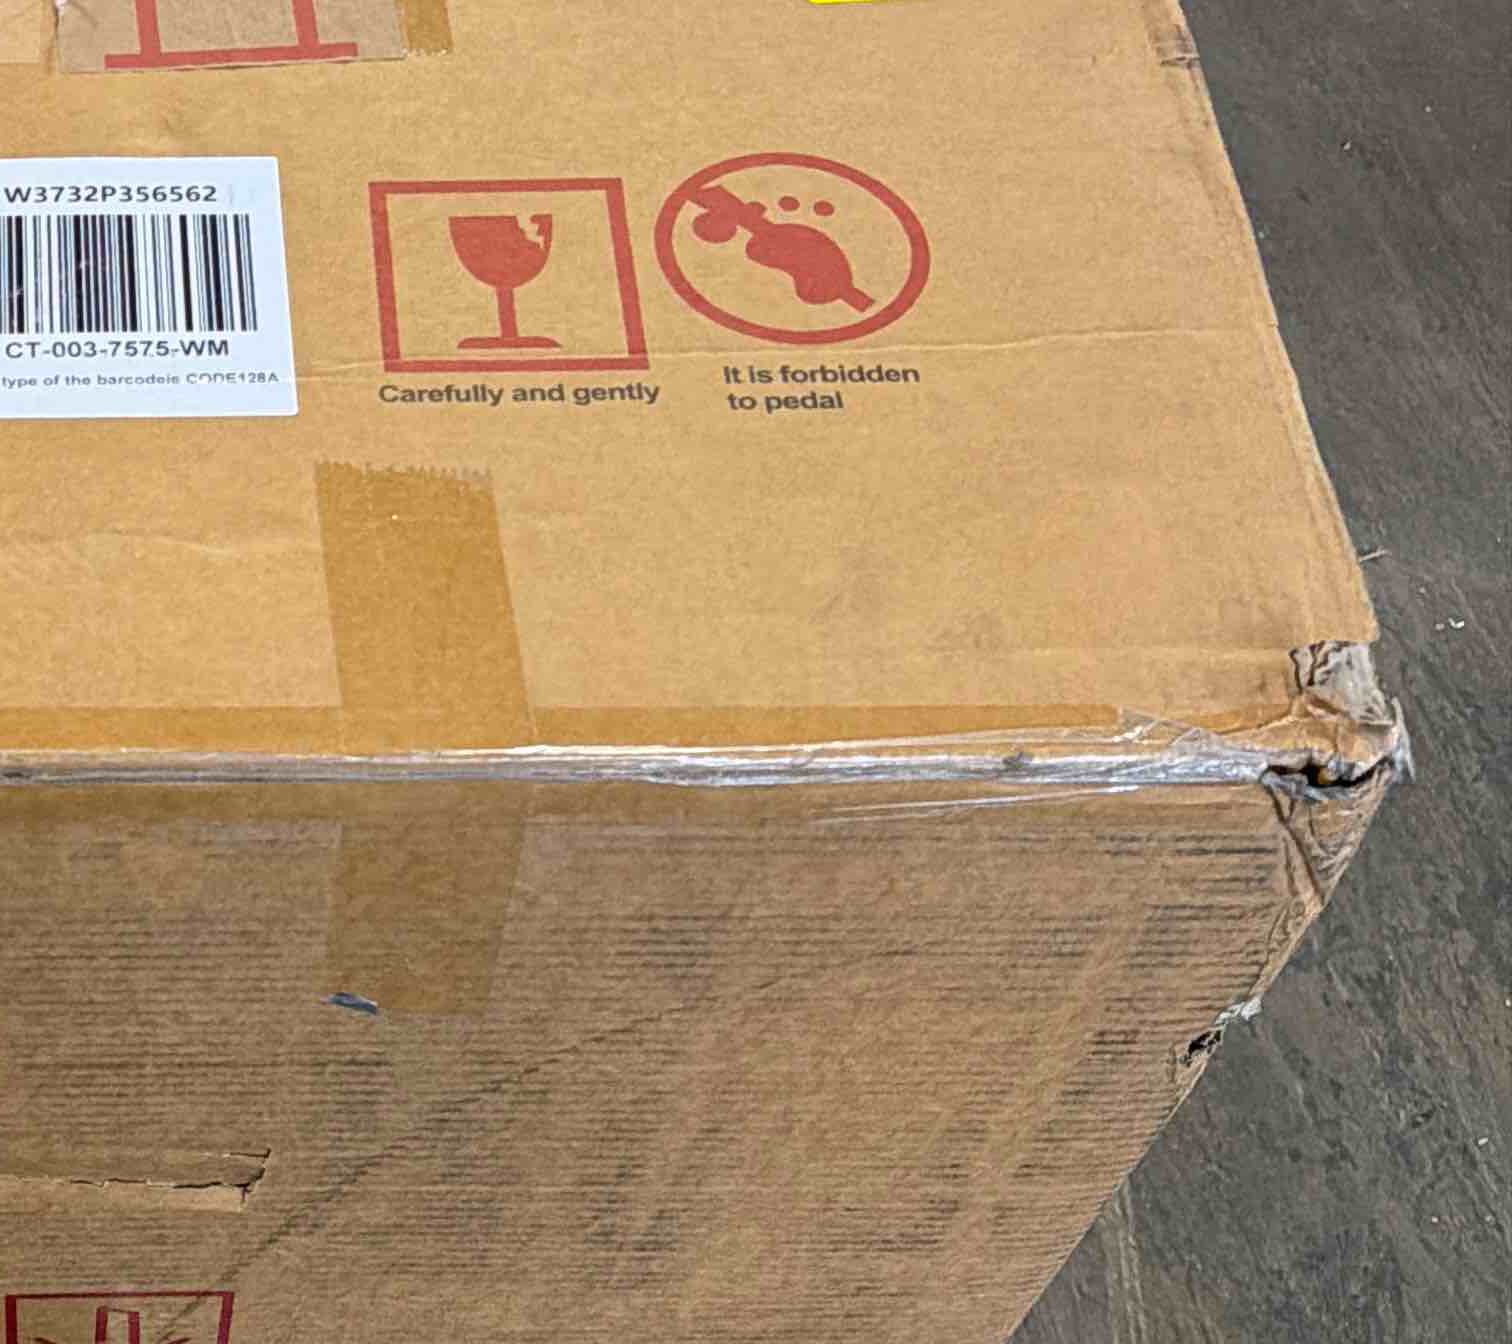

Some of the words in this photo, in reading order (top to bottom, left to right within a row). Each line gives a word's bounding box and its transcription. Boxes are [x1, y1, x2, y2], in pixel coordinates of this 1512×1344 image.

[4, 185, 218, 204] W3732P356562
[5, 339, 230, 359] CT-003-7575-WM
[1, 376, 37, 390] type
[43, 374, 61, 387] of
[65, 374, 91, 387] the
[722, 365, 741, 385] It
[747, 365, 773, 385] is
[779, 364, 921, 385] forbidden
[378, 383, 504, 407] Carefully
[512, 383, 565, 404] and
[573, 382, 661, 406] gently
[728, 392, 757, 412] to
[764, 391, 844, 415] pedal
